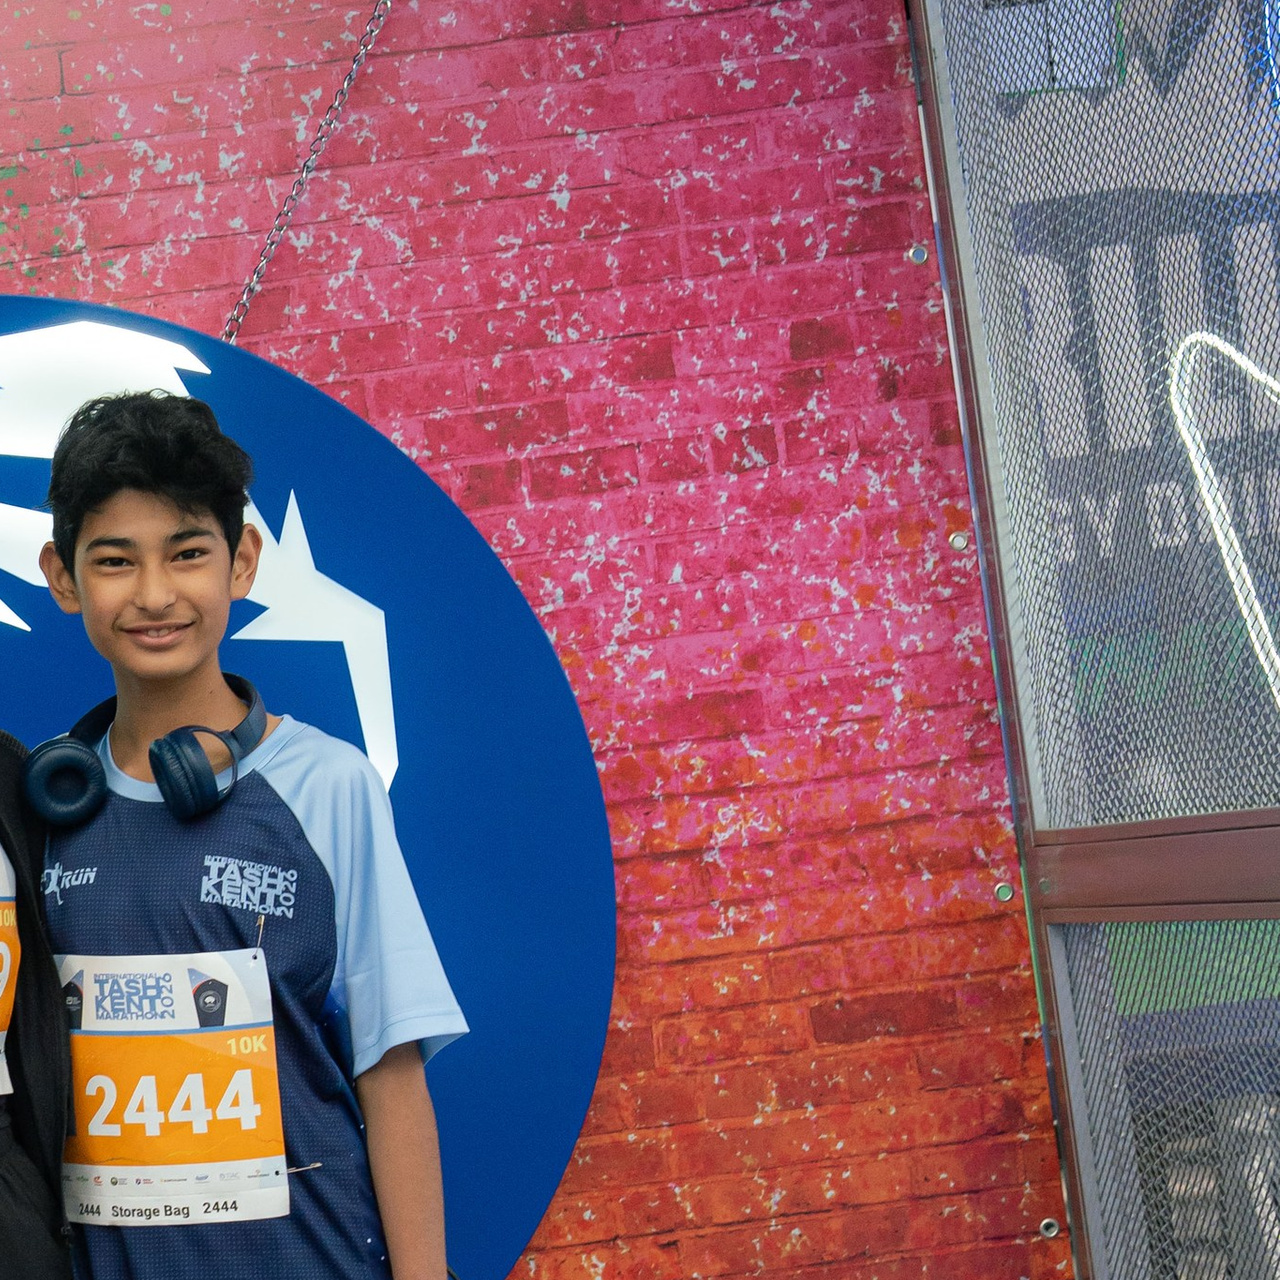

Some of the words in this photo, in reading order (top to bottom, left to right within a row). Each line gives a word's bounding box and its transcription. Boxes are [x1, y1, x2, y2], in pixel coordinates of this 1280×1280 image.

[204, 855, 282, 875] INTERNATIONAL
[204, 861, 284, 896] TASH
[201, 876, 283, 907] KENT
[280, 869, 298, 919] 2026
[201, 893, 283, 917] MARATHON
[94, 978, 161, 997] TASH
[160, 972, 176, 1019] 2026
[95, 994, 161, 1015] KENT
[96, 1010, 164, 1021] MARATHON
[226, 1034, 268, 1056] 10K
[85, 1069, 261, 1137] 2444
[78, 1202, 101, 1217] 2444
[111, 1205, 161, 1220] Storage
[163, 1204, 191, 1219] Bag
[202, 1200, 239, 1214] 2444
